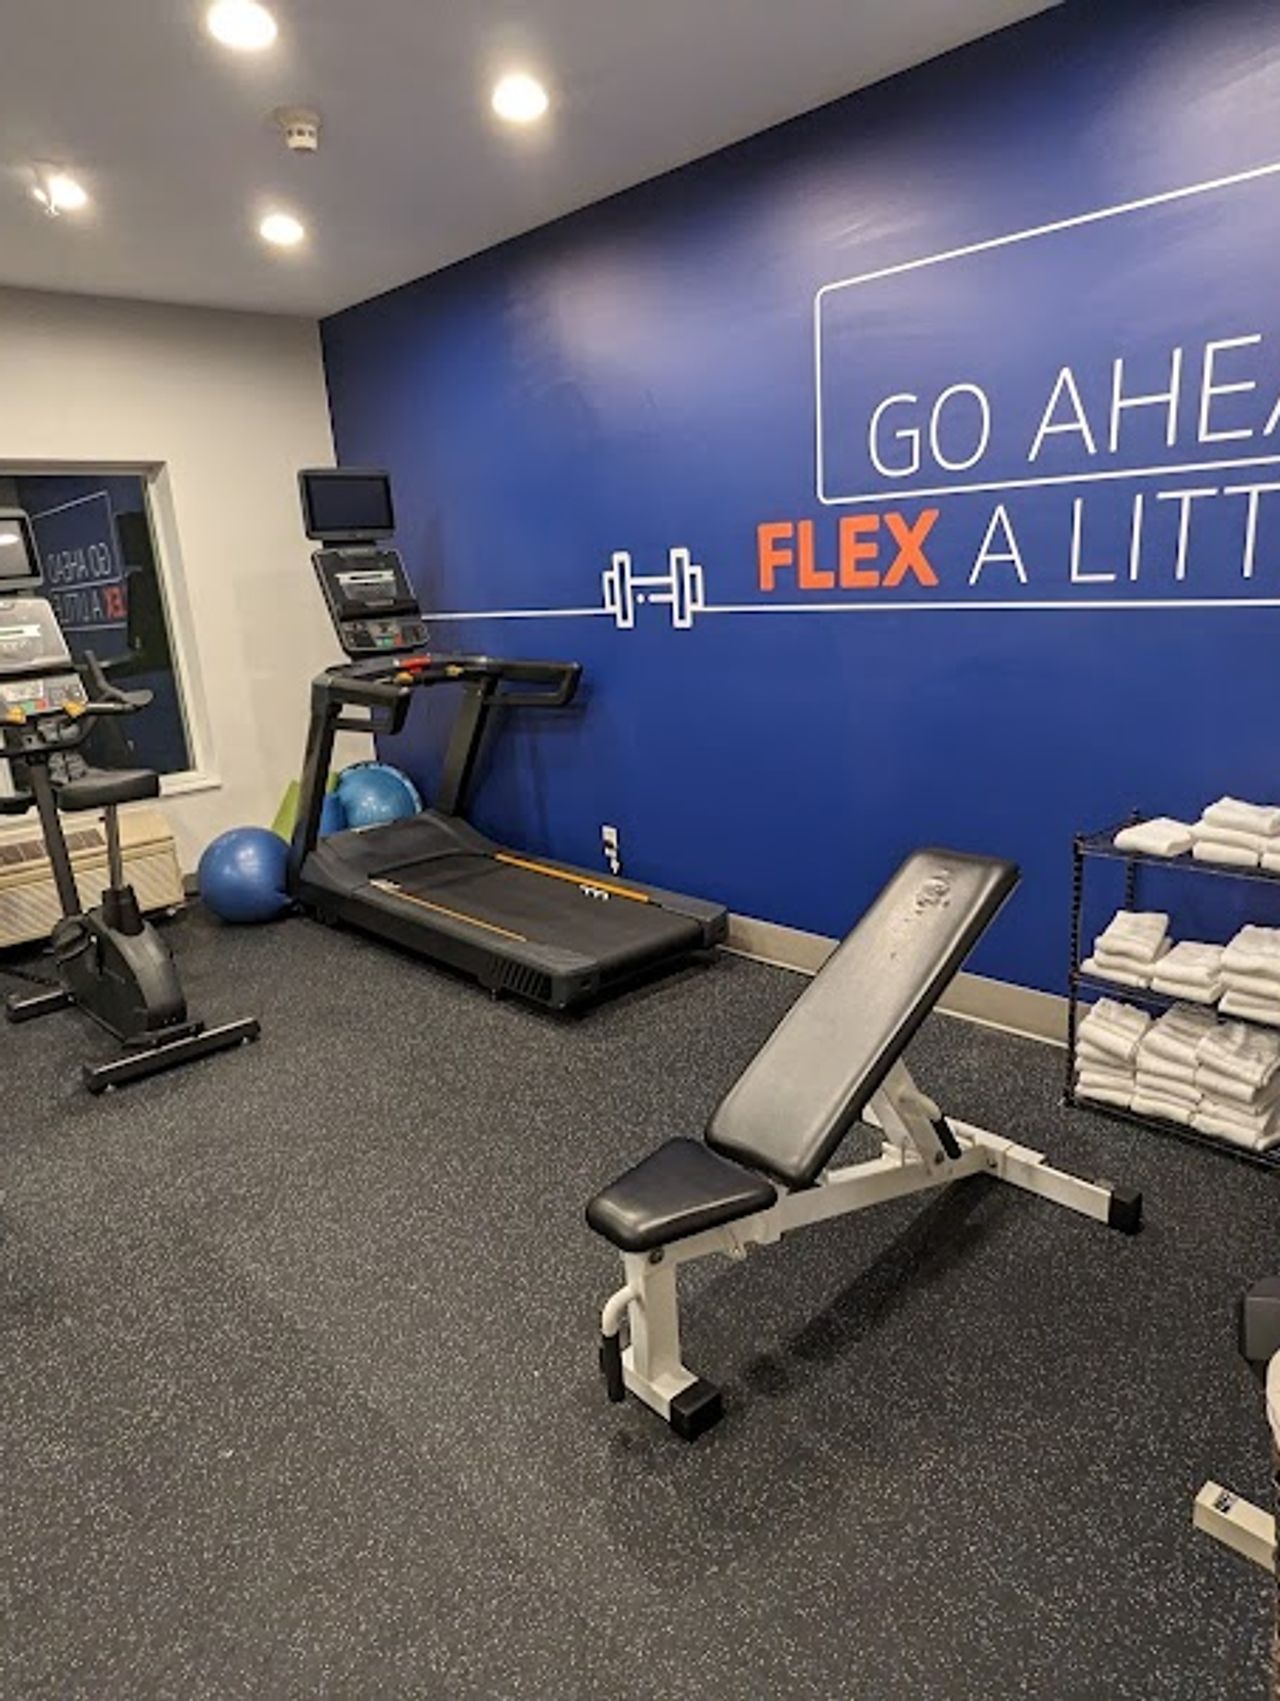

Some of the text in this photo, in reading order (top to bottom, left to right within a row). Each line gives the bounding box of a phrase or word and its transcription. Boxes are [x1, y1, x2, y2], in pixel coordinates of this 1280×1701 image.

[869, 383, 990, 477] GO
[757, 484, 1280, 590] FLEX A LITT
